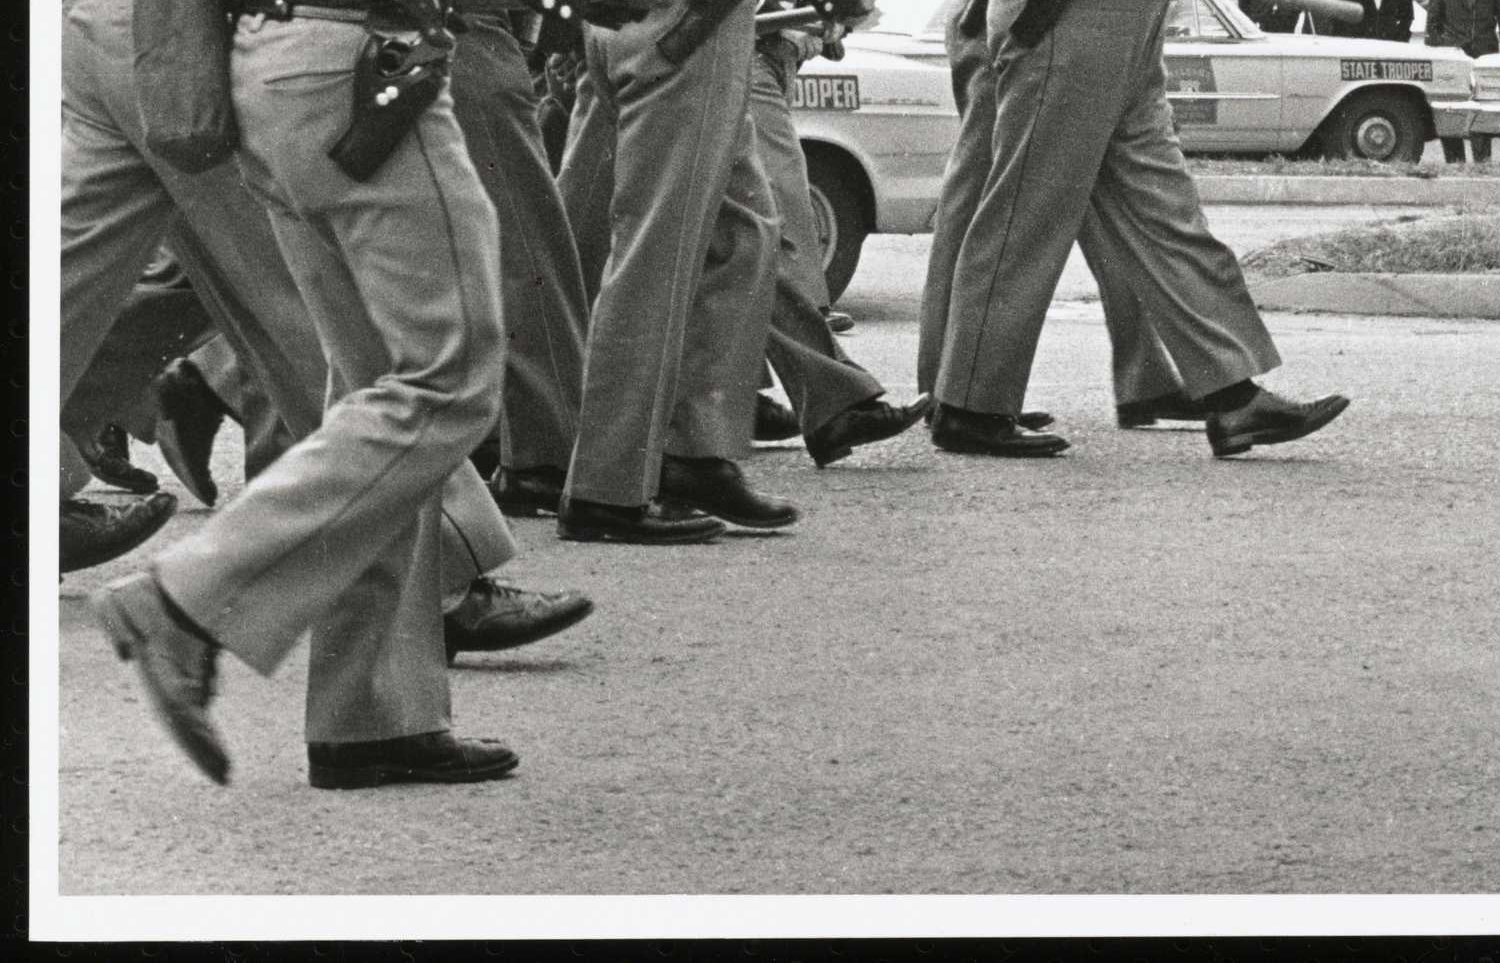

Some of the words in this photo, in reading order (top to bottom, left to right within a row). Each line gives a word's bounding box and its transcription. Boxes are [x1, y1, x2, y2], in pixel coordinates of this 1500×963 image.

[1342, 62, 1378, 79] STATE
[1380, 62, 1432, 80] TROOPER
[792, 78, 858, 108] OOPER
